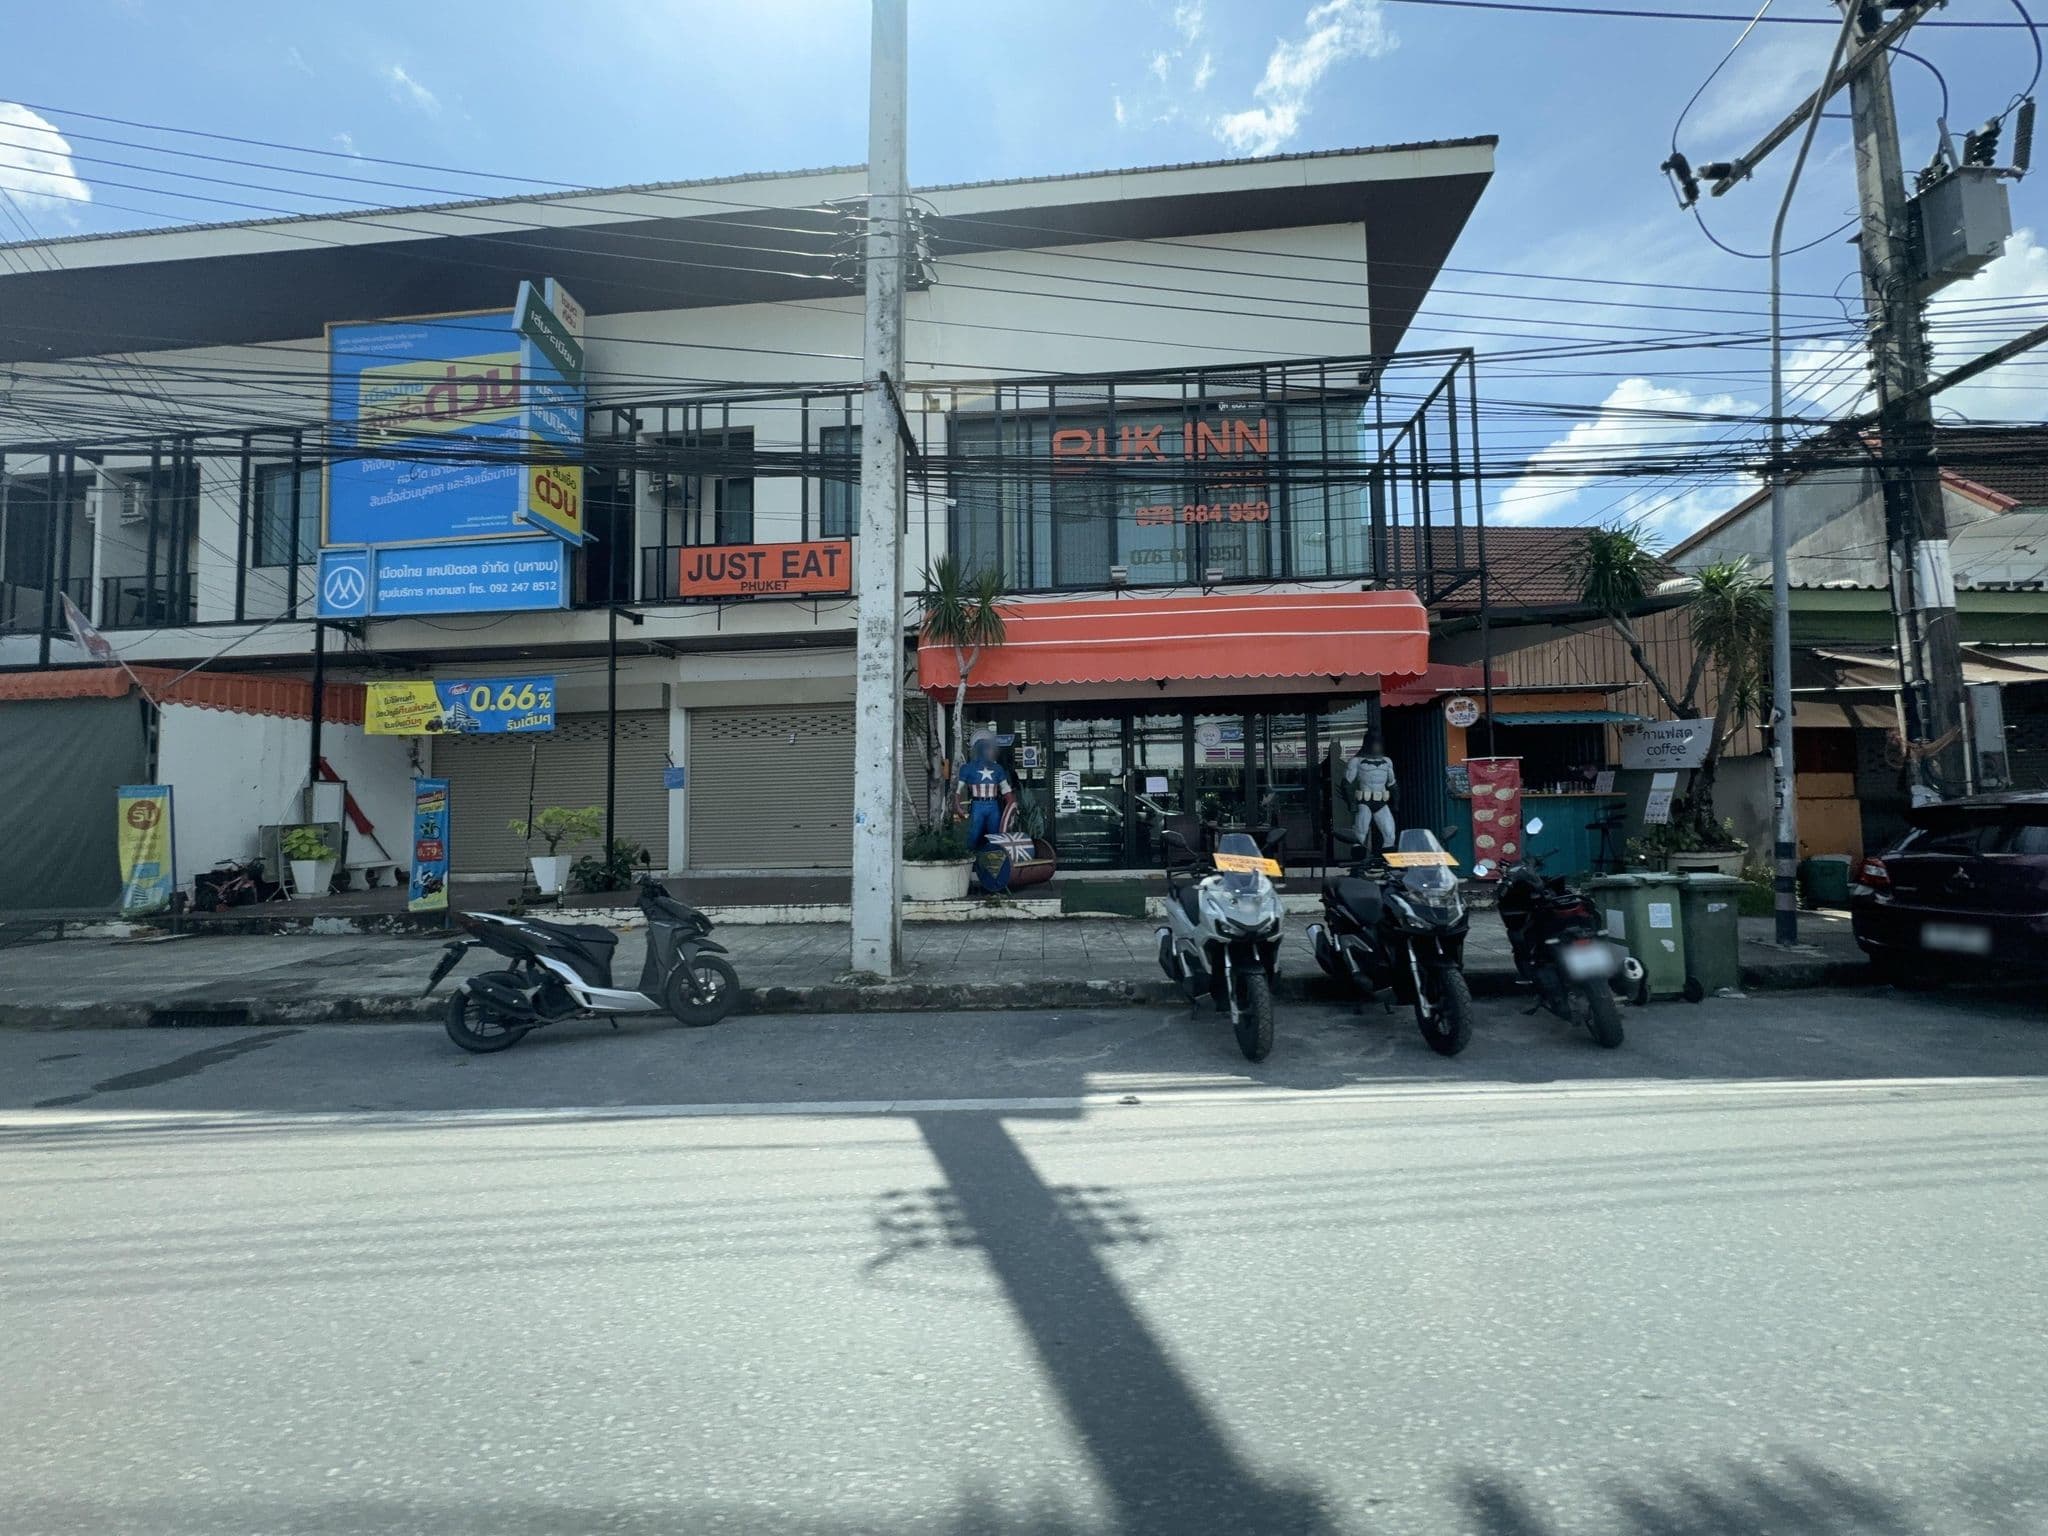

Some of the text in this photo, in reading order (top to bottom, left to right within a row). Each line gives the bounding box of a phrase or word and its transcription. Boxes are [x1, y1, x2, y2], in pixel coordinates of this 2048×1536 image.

[1184, 418, 1269, 461] INN
[1229, 501, 1270, 523] 950
[379, 563, 422, 580] เมืองไทย
[481, 560, 509, 575] จำกัด
[513, 559, 558, 574] (มหาชน)
[687, 548, 842, 582] JUST EAT
[489, 583, 508, 593] 092
[511, 582, 529, 592] 247
[532, 581, 557, 591] 8512
[740, 580, 789, 592] PHUKET
[1643, 726, 1693, 741] กาแฟสด
[1646, 743, 1687, 756] coffee
